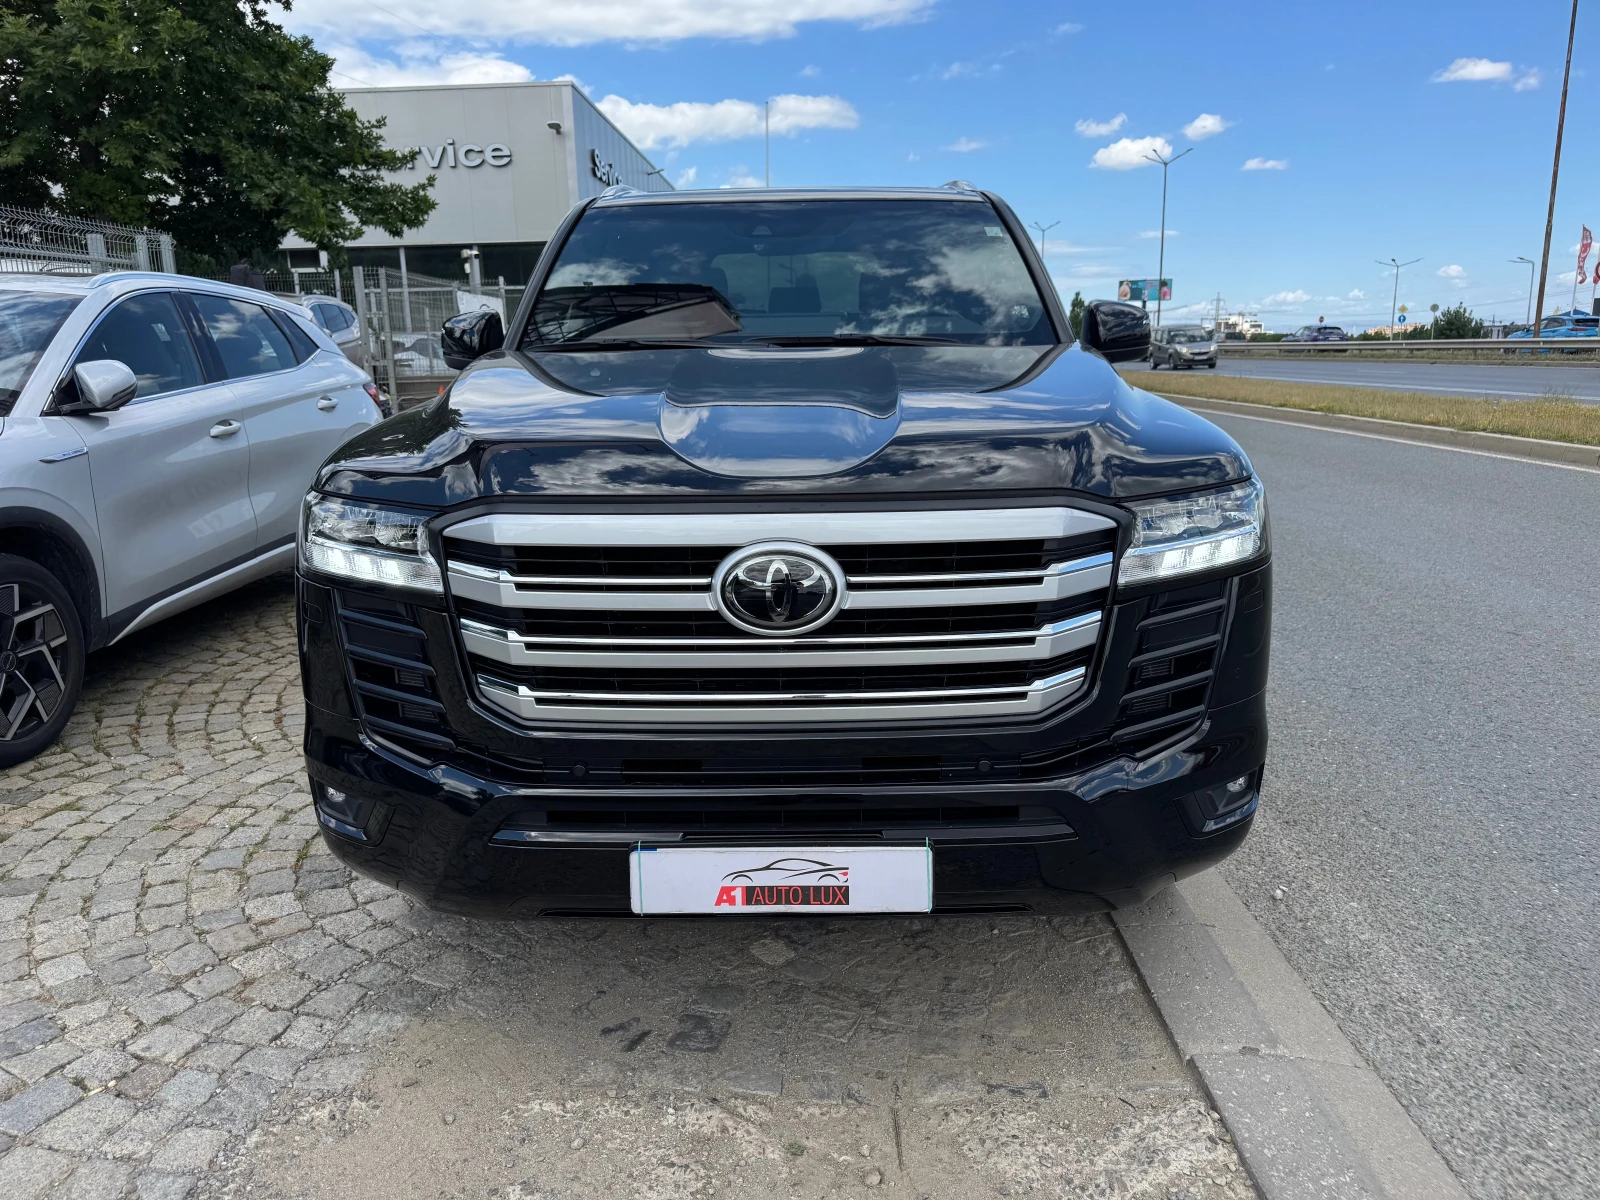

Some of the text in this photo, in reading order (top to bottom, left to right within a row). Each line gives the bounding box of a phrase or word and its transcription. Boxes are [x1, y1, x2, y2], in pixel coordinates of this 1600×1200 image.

[358, 138, 512, 171] rvice
[714, 886, 847, 906] A1 AUTO LUX
